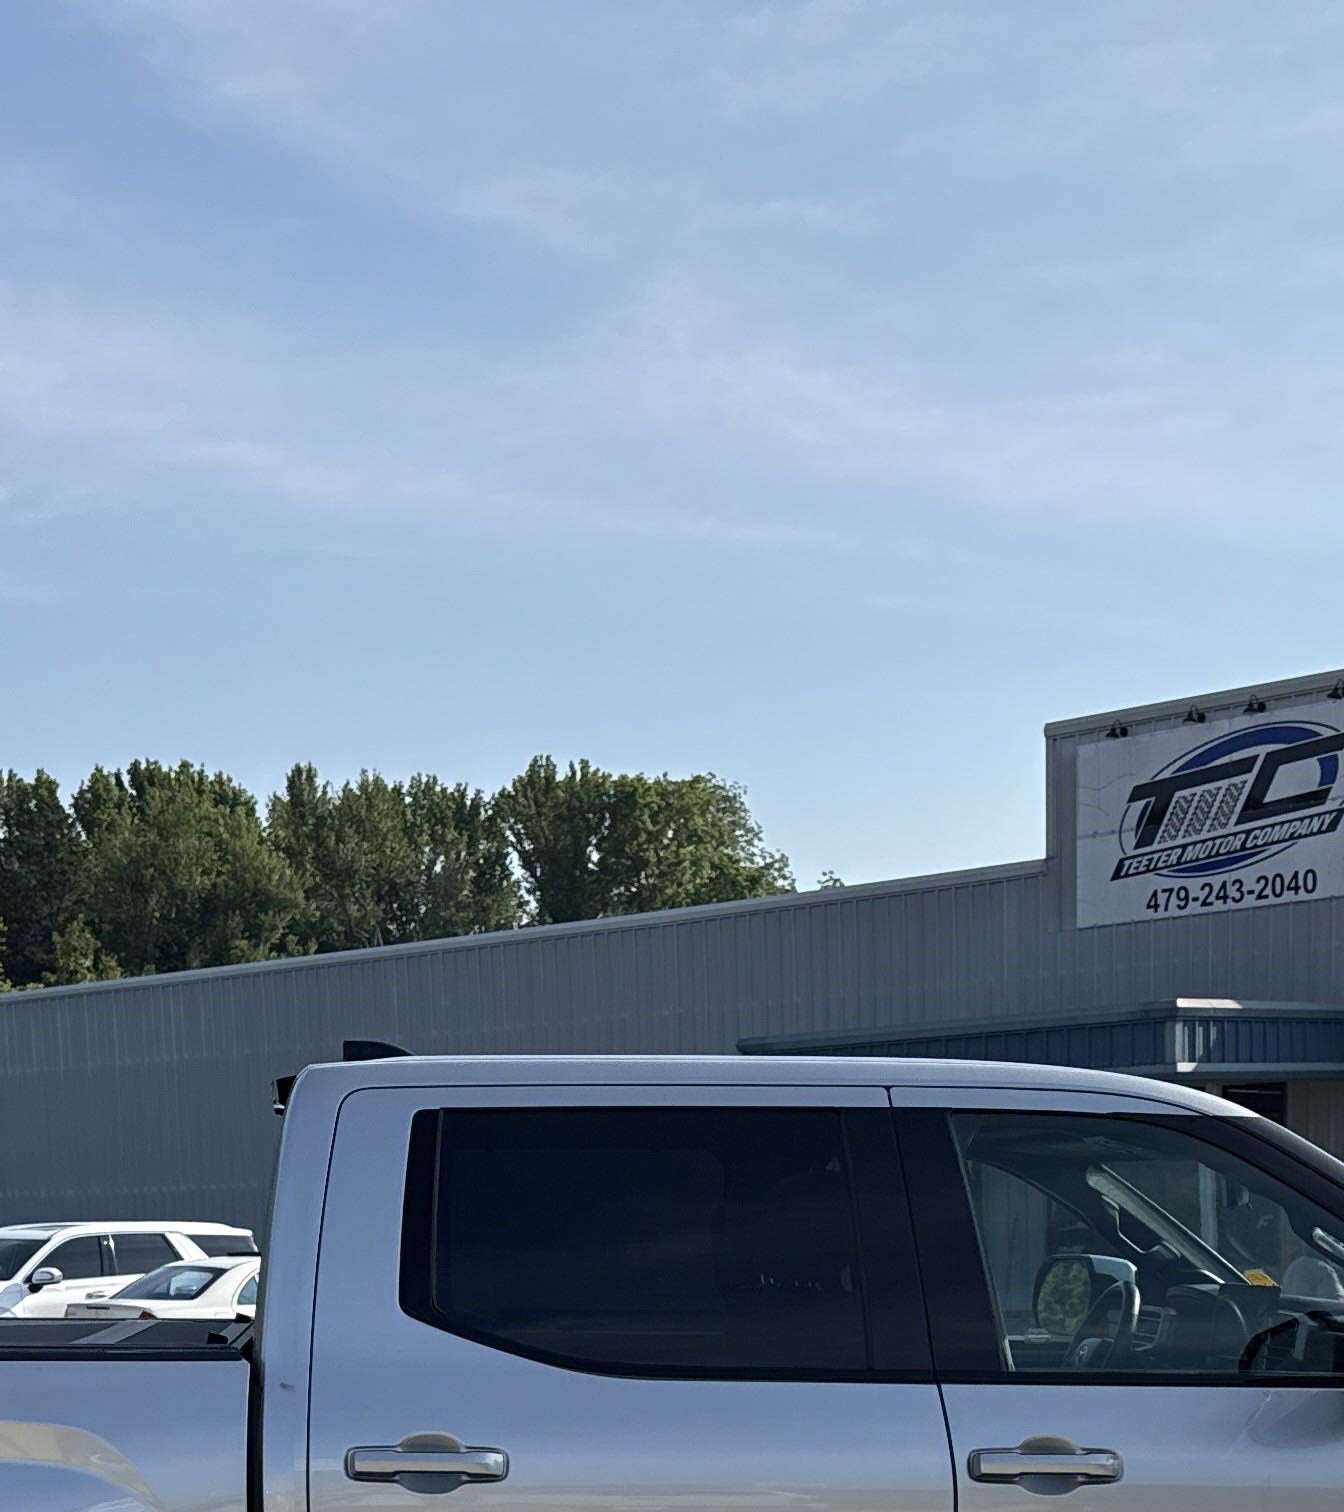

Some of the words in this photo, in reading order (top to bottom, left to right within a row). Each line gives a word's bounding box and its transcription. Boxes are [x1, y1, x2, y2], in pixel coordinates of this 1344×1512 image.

[1119, 852, 1181, 876] TEETER
[1181, 834, 1247, 863] MOTOR
[1246, 811, 1338, 848] COMPANY
[1146, 868, 1318, 913] 479-243-2040
